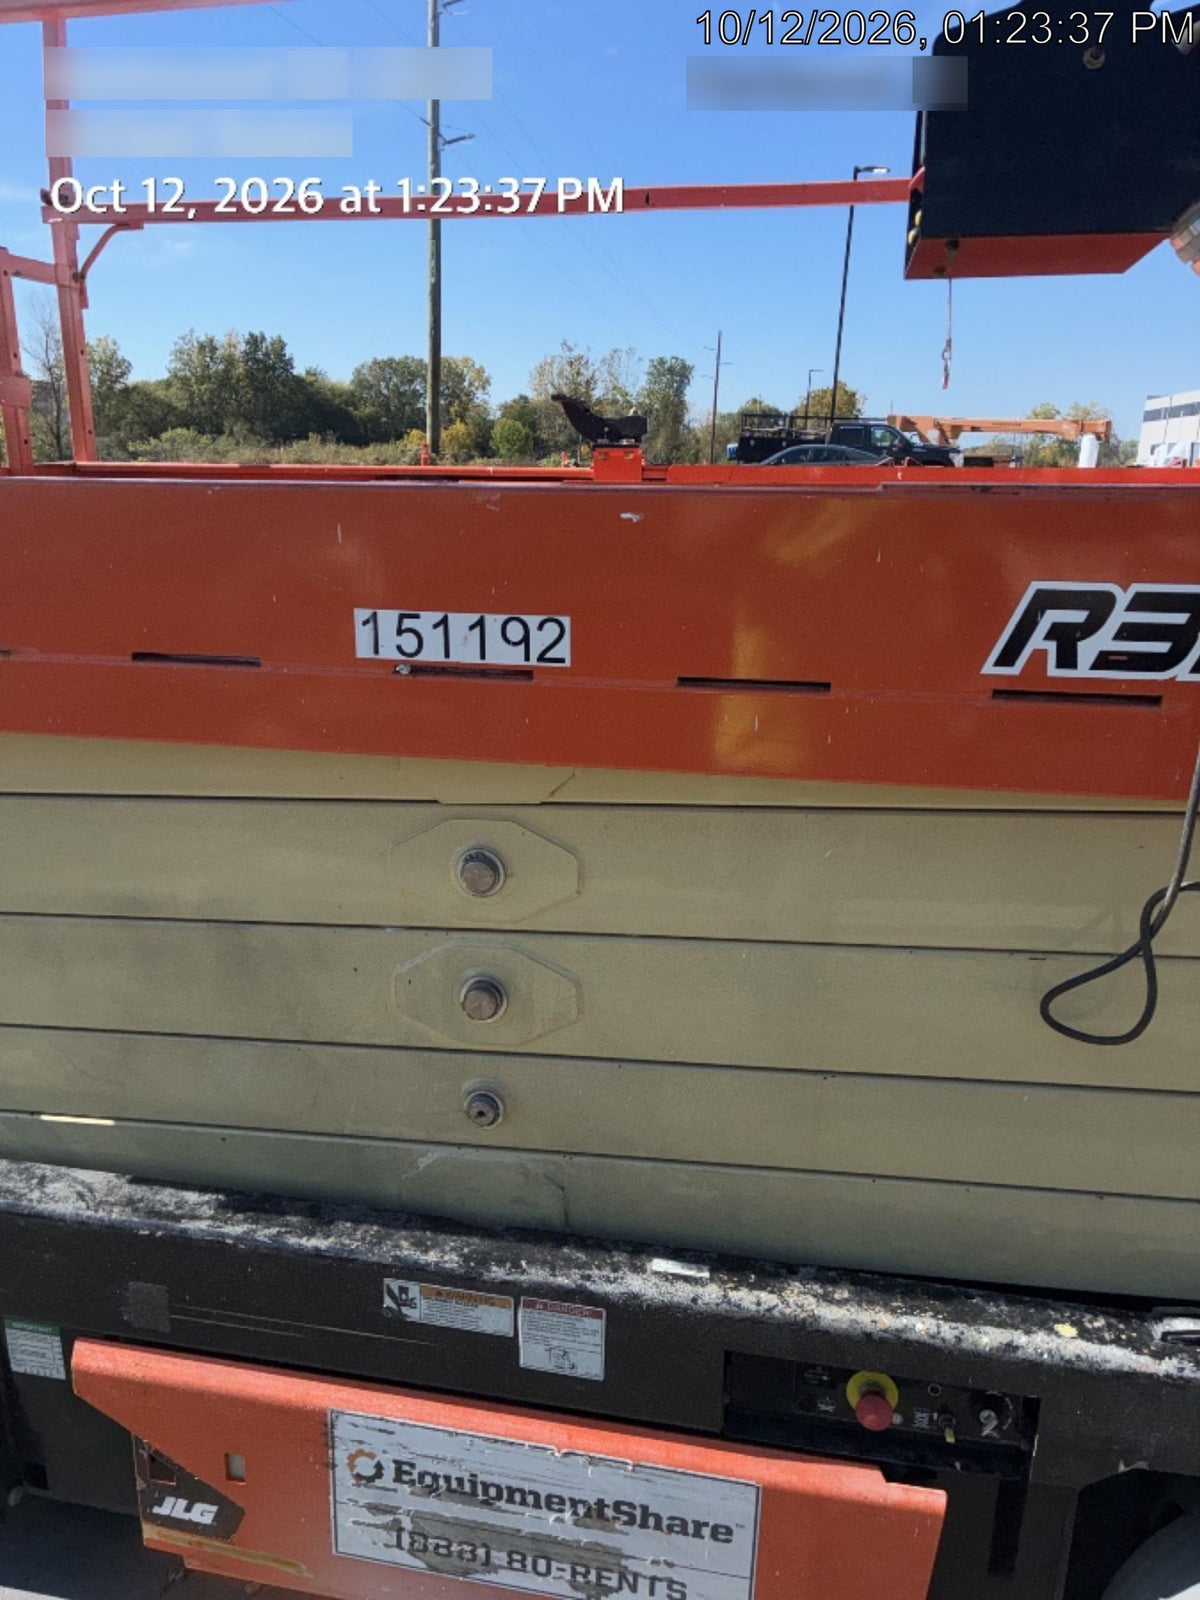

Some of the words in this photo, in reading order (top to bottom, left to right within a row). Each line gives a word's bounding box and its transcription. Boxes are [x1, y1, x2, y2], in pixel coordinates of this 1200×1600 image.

[361, 611, 567, 664] 151192
[980, 581, 1200, 681] R3
[152, 1496, 219, 1525] JLG
[392, 1459, 734, 1544] EquipmentShare
